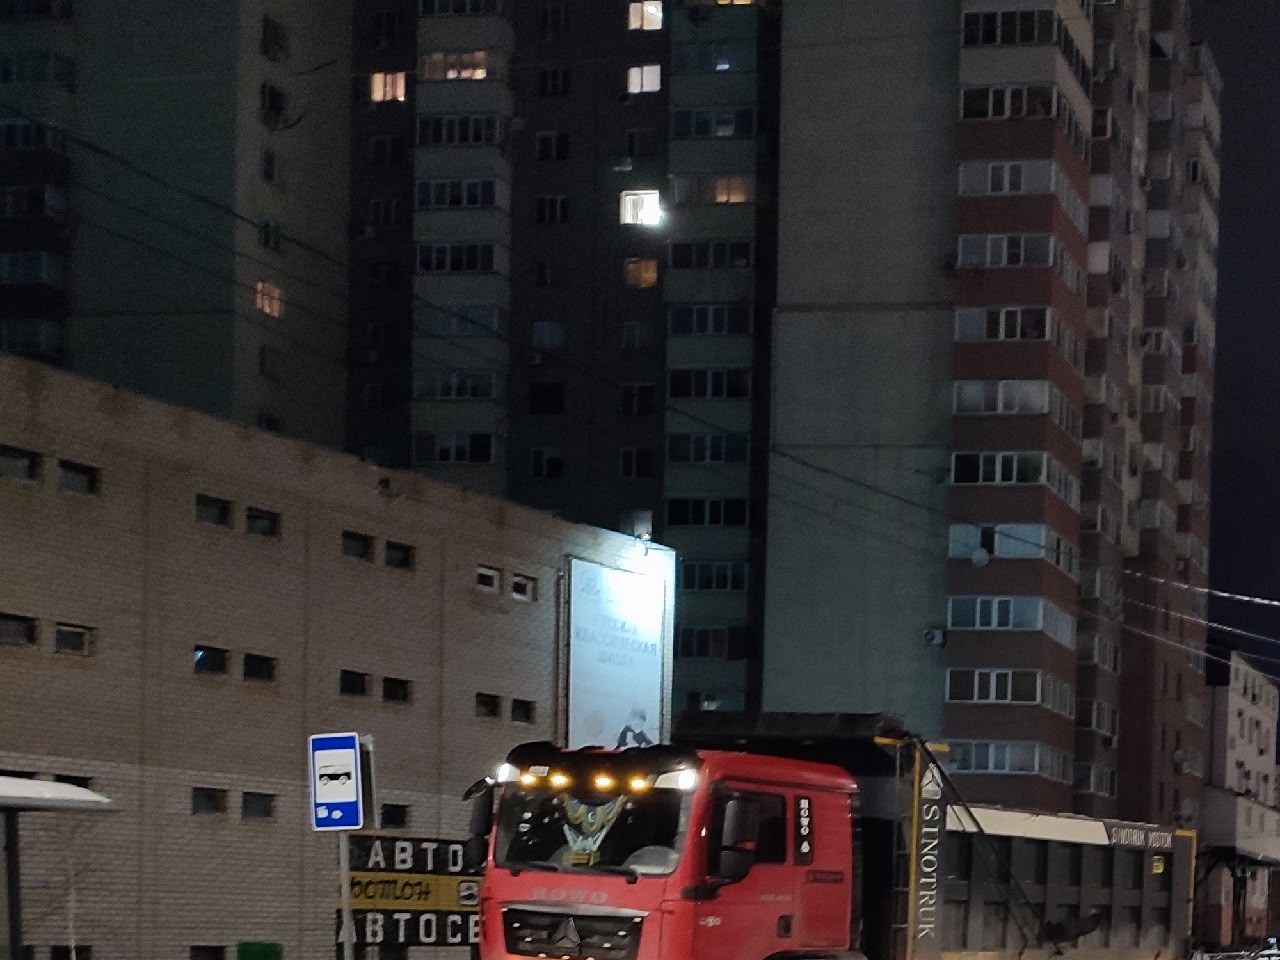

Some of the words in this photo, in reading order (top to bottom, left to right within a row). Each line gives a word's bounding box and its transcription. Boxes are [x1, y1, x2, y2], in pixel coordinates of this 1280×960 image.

[1111, 827, 1146, 847] SINOTRUK
[368, 839, 475, 873] АВТО
[918, 803, 940, 939] SINOTRUK
